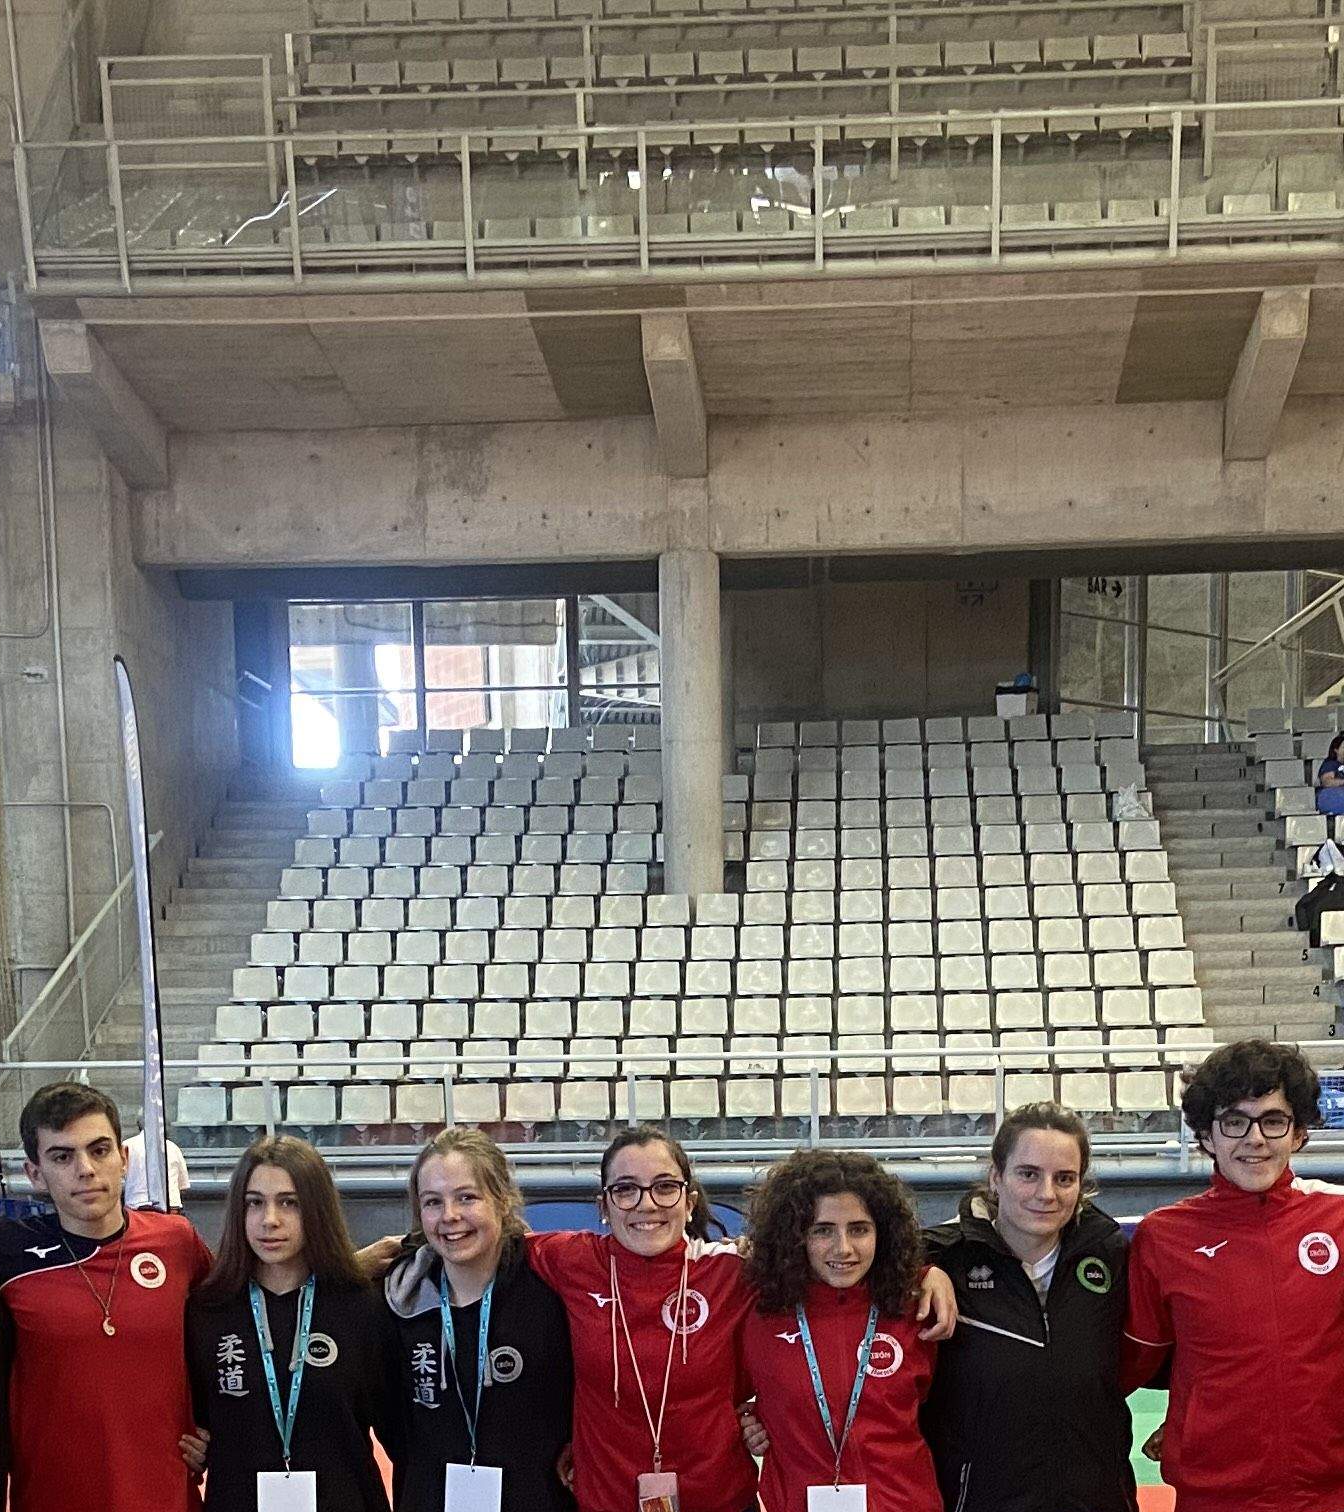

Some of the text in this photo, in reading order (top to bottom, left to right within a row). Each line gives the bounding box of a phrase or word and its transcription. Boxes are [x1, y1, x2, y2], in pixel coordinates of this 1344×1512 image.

[1087, 577, 1107, 594] BAR
[216, 1332, 250, 1398] 柔道
[412, 1342, 441, 1409] 柔道
